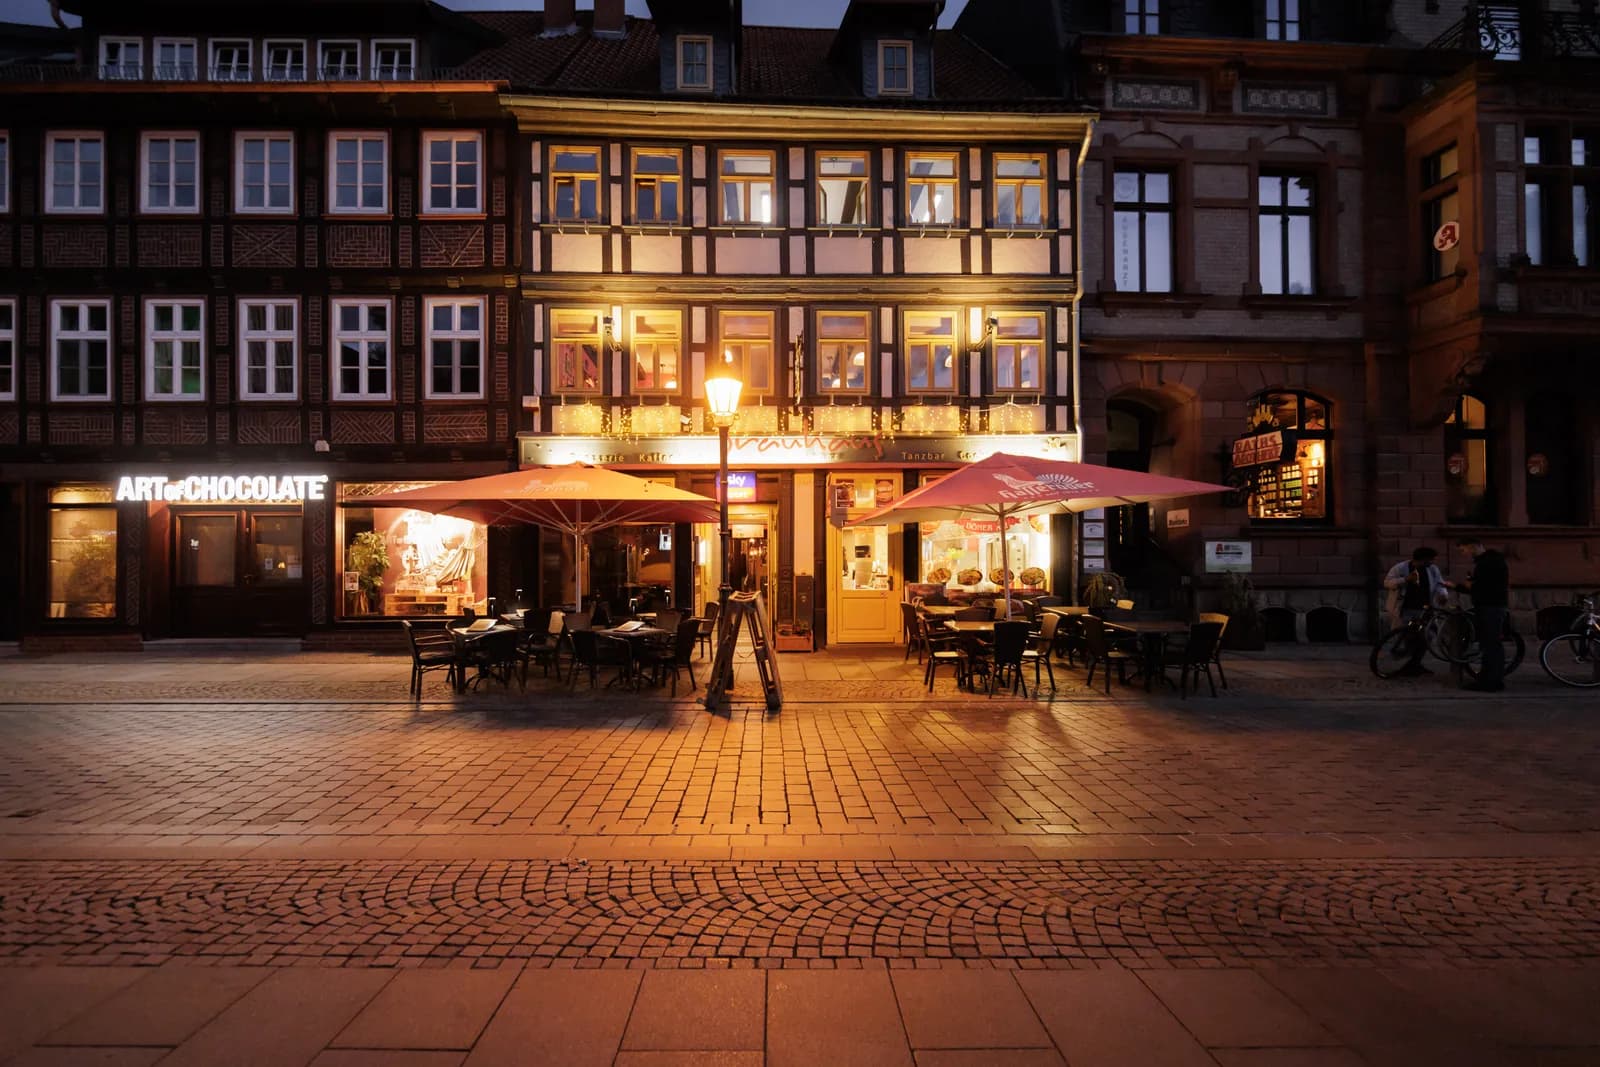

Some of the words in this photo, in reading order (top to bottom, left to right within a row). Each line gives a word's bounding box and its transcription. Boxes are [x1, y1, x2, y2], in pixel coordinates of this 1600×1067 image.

[902, 452, 945, 461] Tanzbar
[727, 473, 746, 487] sky
[116, 476, 168, 501] ART
[184, 475, 325, 501] CHOCOLATE
